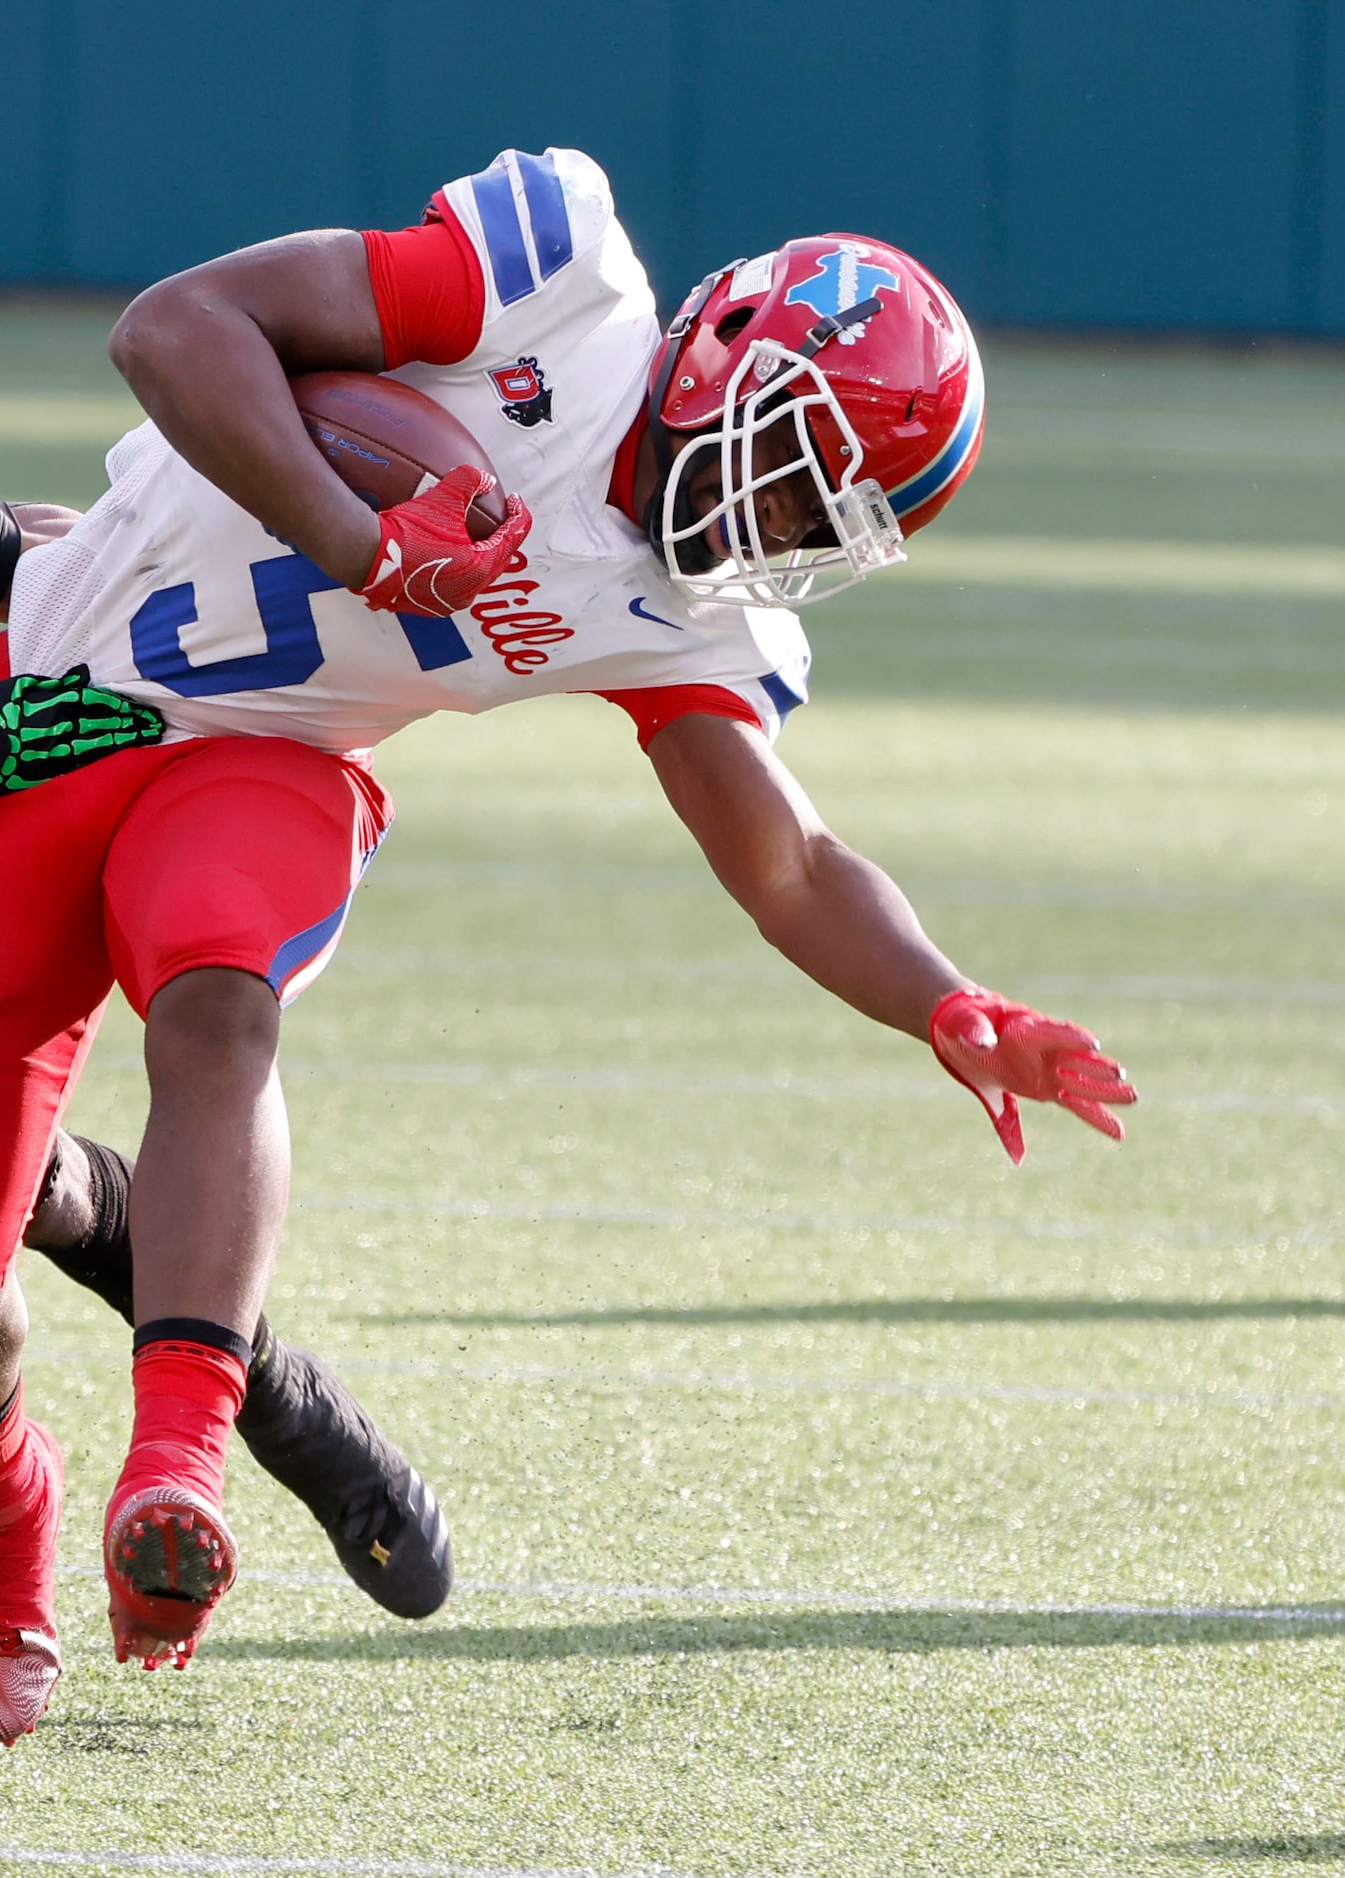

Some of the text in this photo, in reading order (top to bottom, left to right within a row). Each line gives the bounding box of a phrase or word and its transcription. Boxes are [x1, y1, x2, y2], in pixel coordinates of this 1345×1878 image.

[337, 436, 392, 470] VAPOR
[869, 503, 889, 530] schutt
[129, 551, 473, 698] 5
